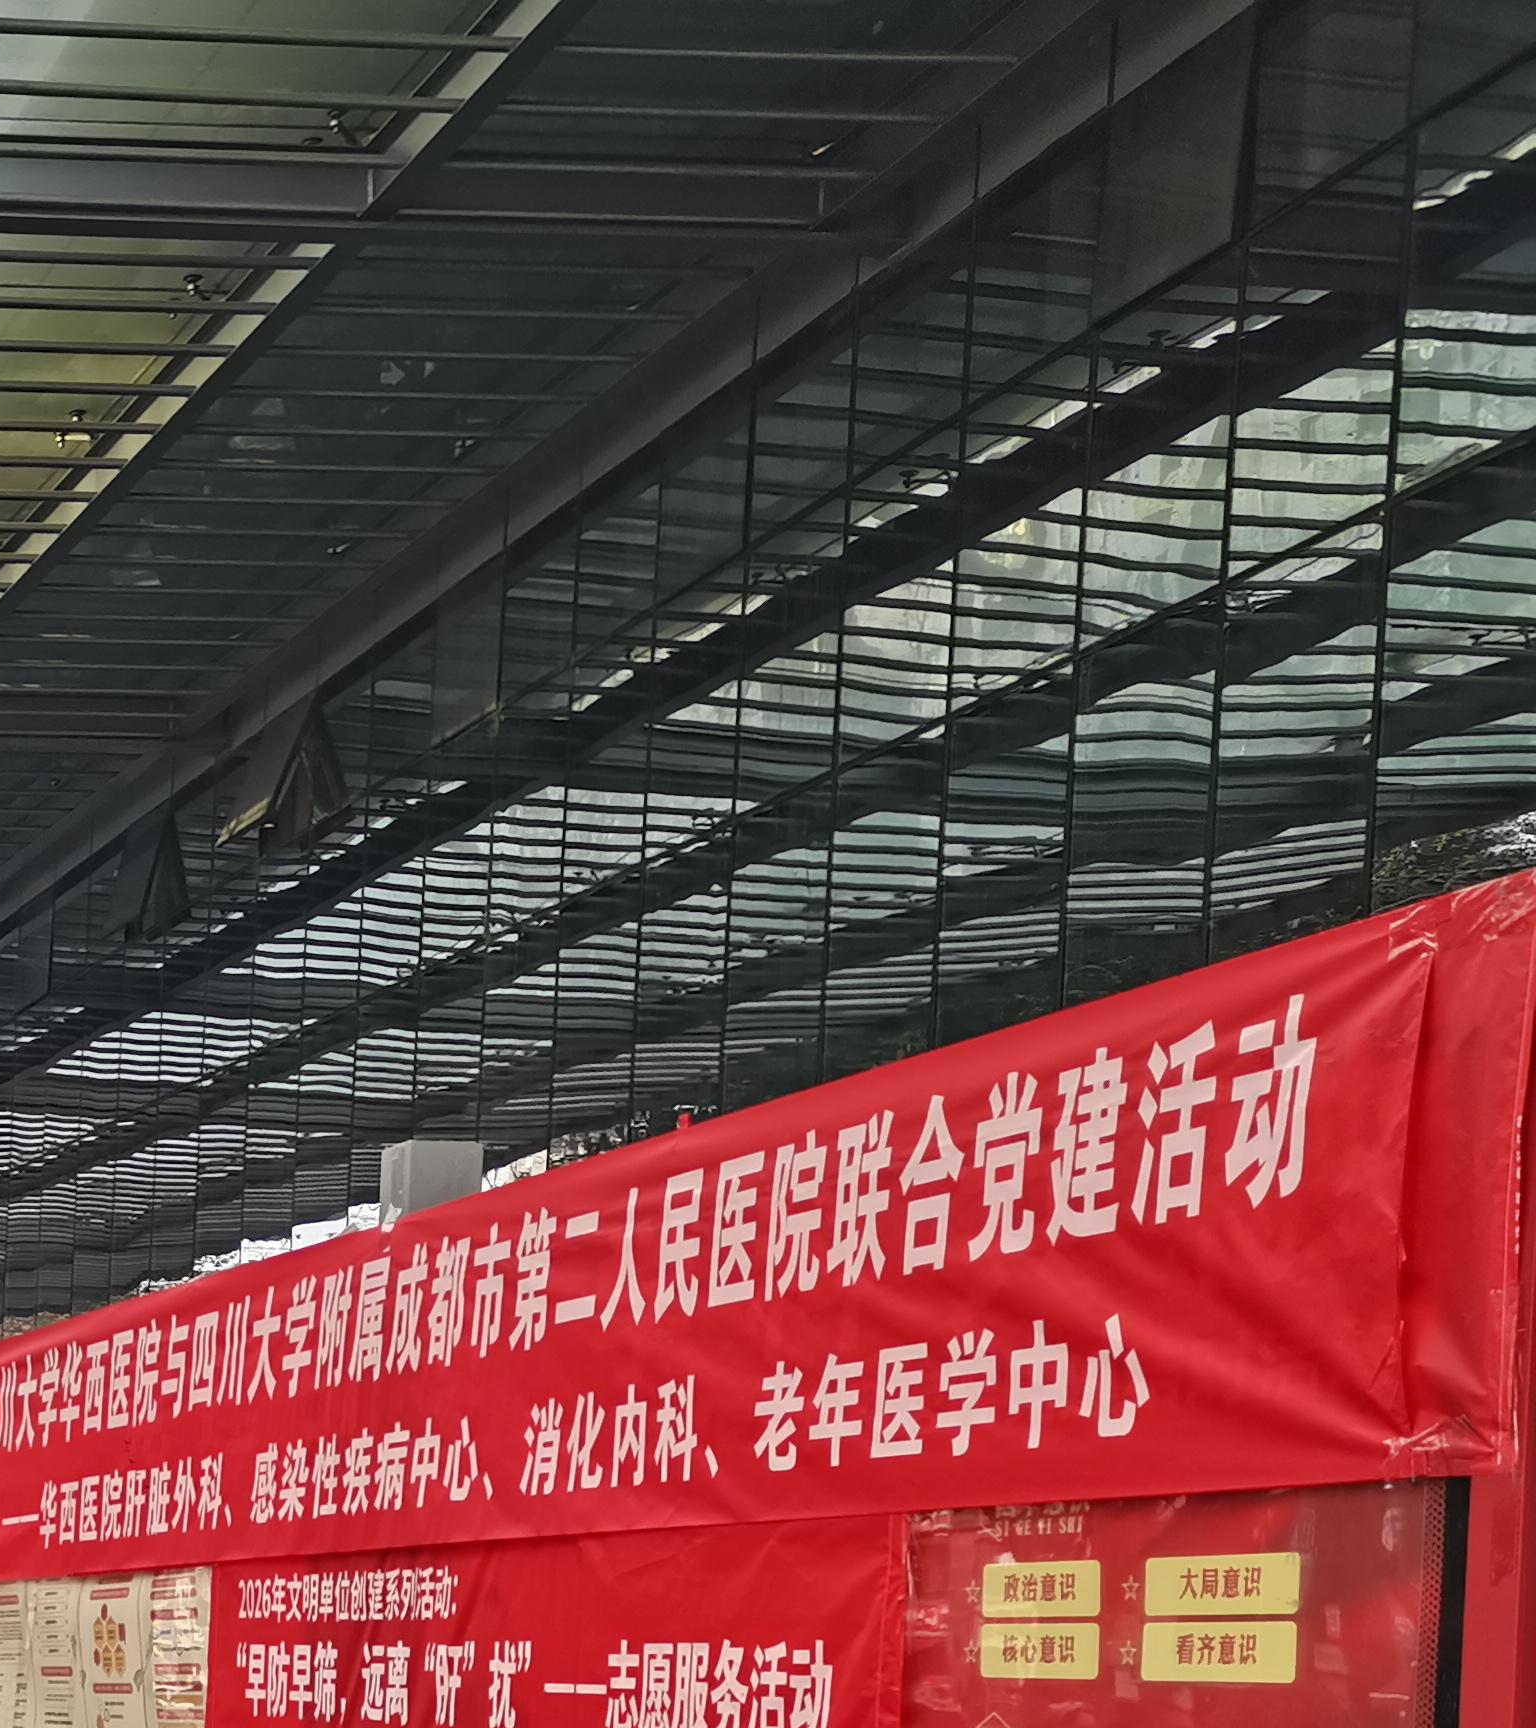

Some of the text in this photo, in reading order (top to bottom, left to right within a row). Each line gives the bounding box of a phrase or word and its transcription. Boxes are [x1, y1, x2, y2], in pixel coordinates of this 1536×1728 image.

[1003, 1572, 1077, 1603] 政治意识
[1179, 1566, 1262, 1600] 大局意识
[1002, 1633, 1076, 1665] 核心意识
[1176, 1632, 1258, 1666] 看齐意识
